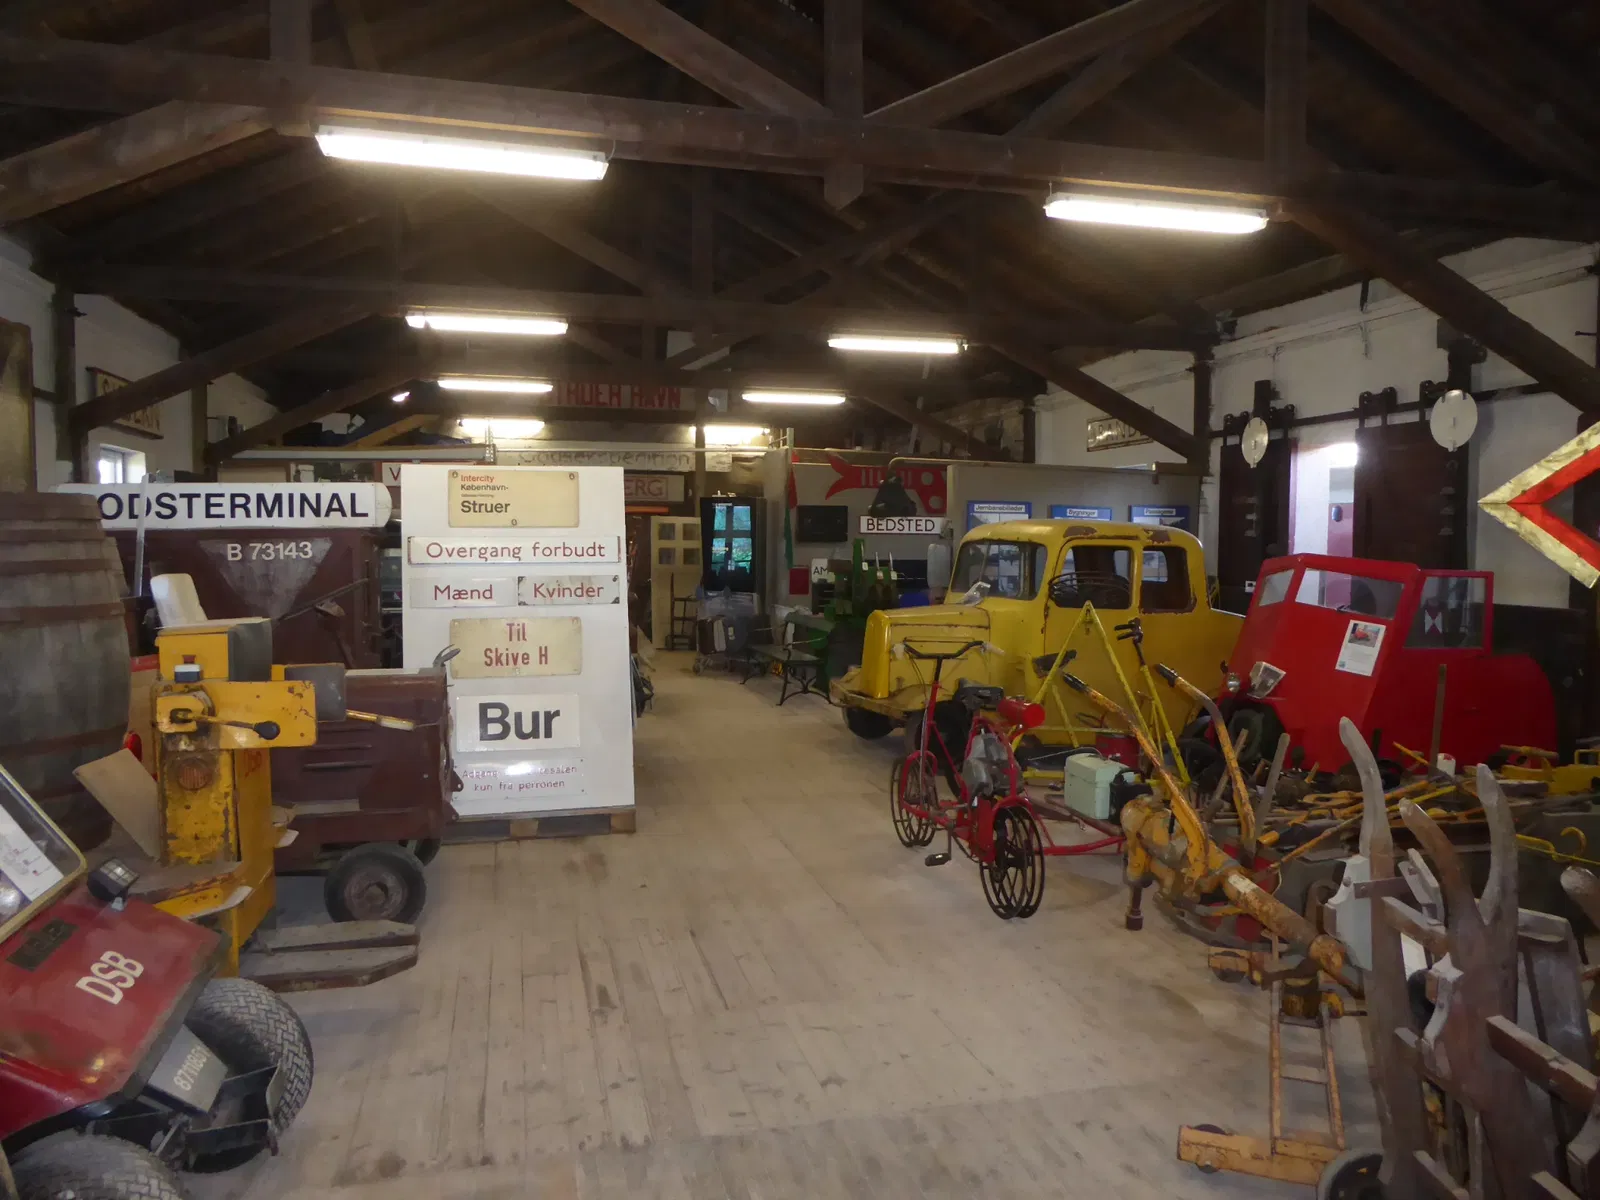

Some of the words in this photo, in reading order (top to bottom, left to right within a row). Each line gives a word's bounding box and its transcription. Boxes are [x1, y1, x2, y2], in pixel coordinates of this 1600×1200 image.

[460, 474, 495, 484] Intercity
[460, 483, 509, 491] København-
[624, 479, 663, 498] ERG
[99, 492, 369, 520] ODSTERMINAL
[460, 500, 510, 513] Struer
[866, 518, 936, 532] BEDSTED
[227, 544, 242, 561] B
[250, 541, 313, 560] 73143
[426, 542, 523, 562] Overgang
[532, 542, 606, 558] forbudt
[433, 585, 494, 601] Mænd
[533, 580, 604, 599] Kvinder
[506, 622, 527, 642] Til
[484, 648, 530, 667] Skive
[538, 646, 549, 665] H
[478, 702, 561, 742] Bur
[474, 783, 493, 792] kun
[499, 781, 513, 791] fra
[518, 780, 565, 791] perronen
[76, 951, 144, 1005] DSB
